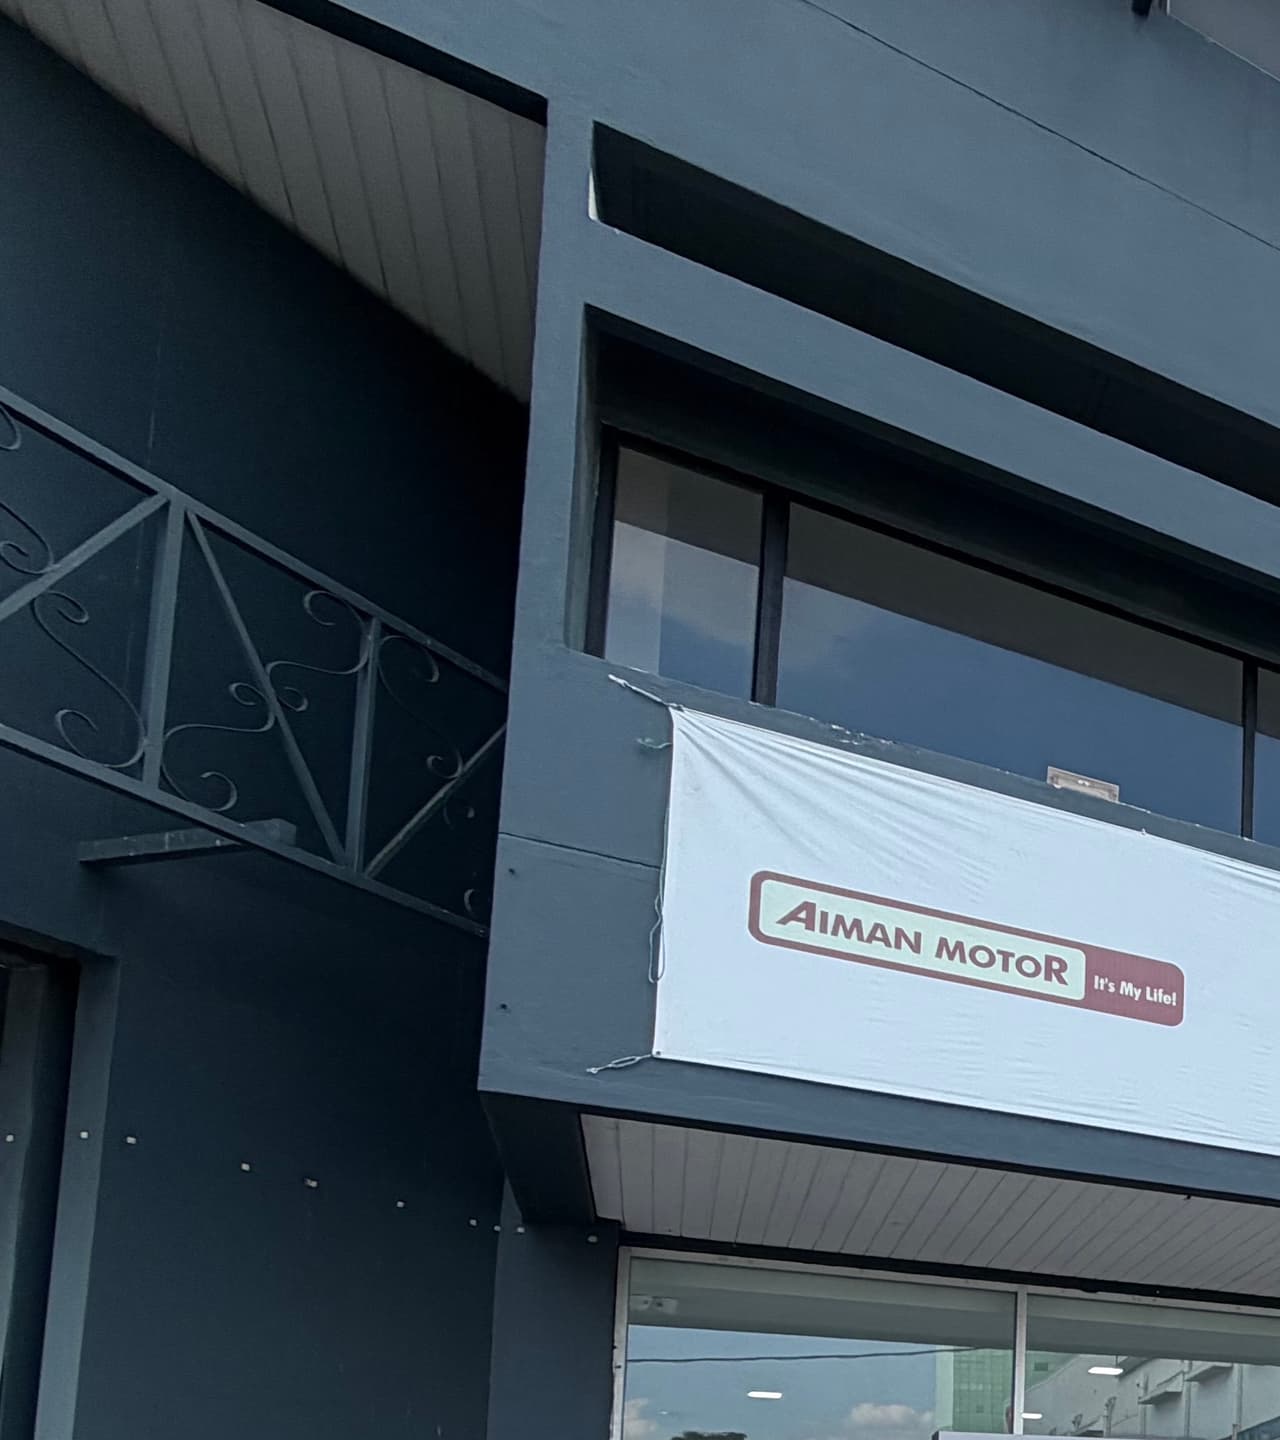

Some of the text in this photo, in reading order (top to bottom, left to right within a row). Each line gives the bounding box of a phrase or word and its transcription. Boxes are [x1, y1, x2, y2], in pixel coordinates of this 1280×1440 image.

[776, 900, 1069, 986] AIMAN MOTOR
[1093, 975, 1178, 1007] It's My Life!
